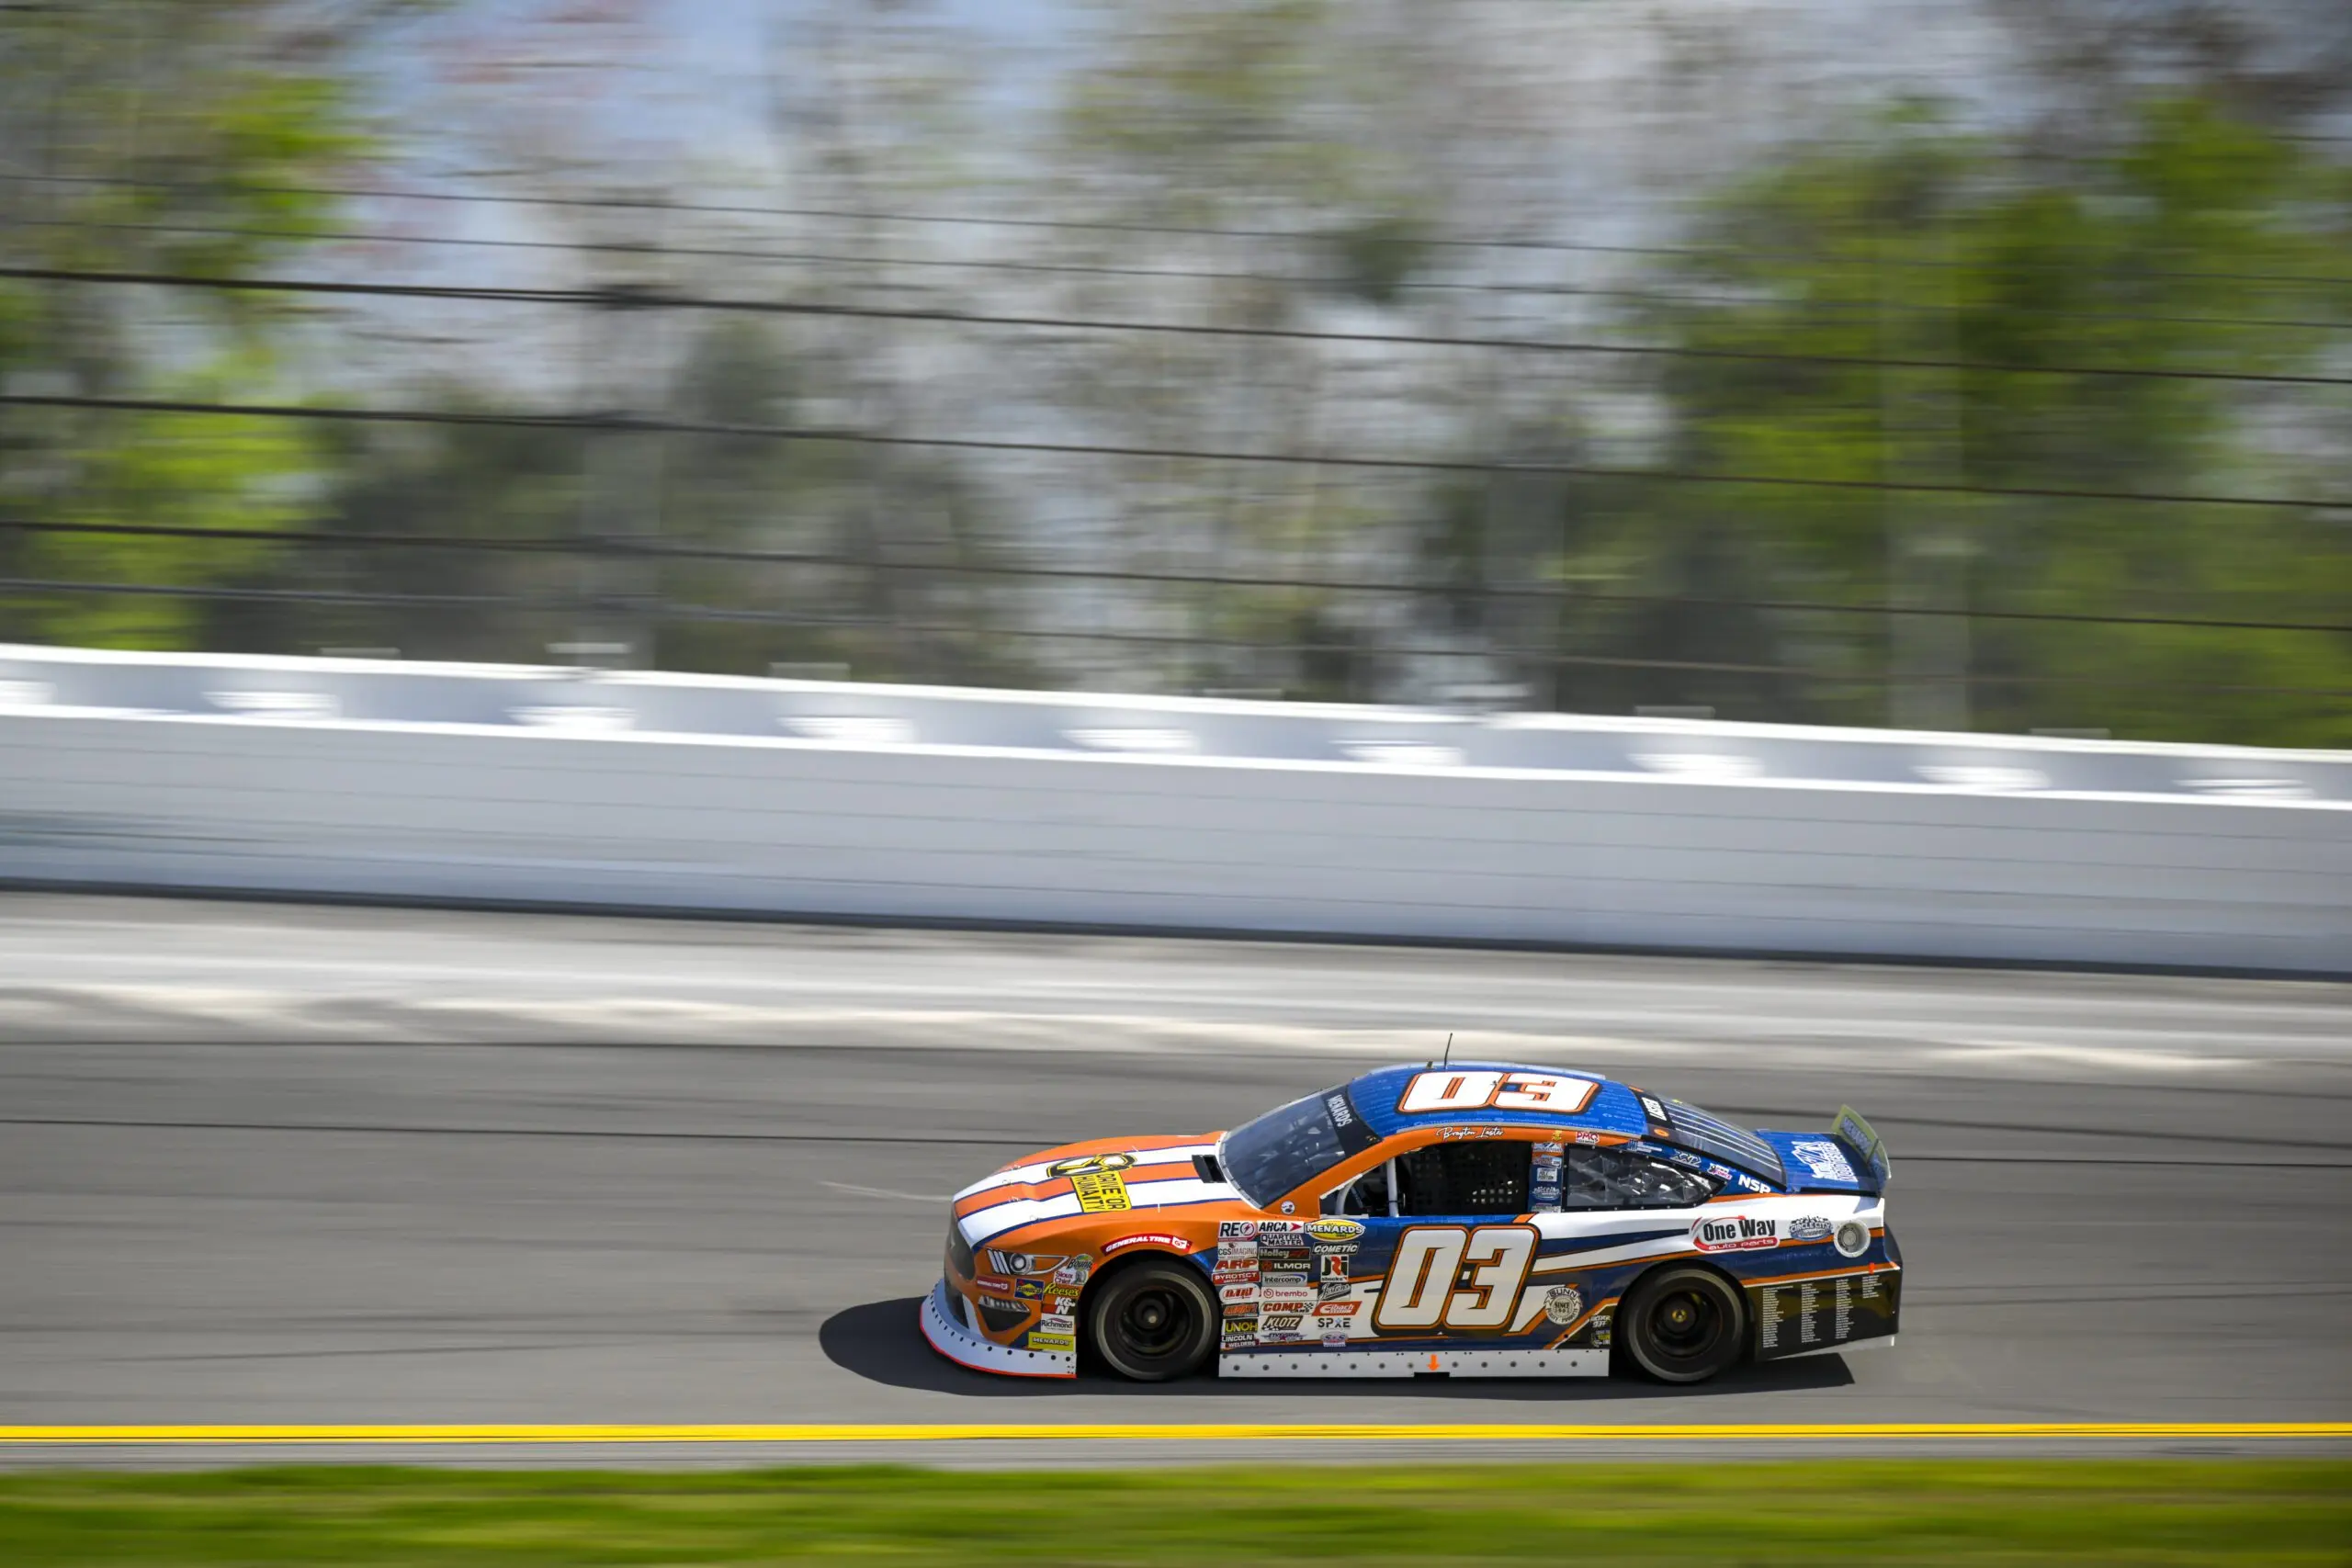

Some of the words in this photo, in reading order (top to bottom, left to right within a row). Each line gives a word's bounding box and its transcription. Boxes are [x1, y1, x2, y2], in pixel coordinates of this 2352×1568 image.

[1398, 1071, 1600, 1113] 03
[1327, 1094, 1352, 1127] MENARDS
[1436, 1126, 1476, 1142] Brayton
[1475, 1126, 1504, 1138] Laster
[1738, 1175, 1770, 1193] NSP
[1259, 1222, 1286, 1232] ARCA
[1306, 1224, 1363, 1233] MENARDS
[1703, 1223, 1736, 1241] One
[1738, 1219, 1775, 1237] Way
[1105, 1236, 1148, 1252] GENERAL
[1148, 1235, 1170, 1244] TIRE
[1741, 1239, 1774, 1247] parts
[1260, 1248, 1290, 1258] Holley
[1215, 1259, 1258, 1269] ARP
[1374, 1225, 1540, 1329] 03
[1263, 1303, 1303, 1311] COMP
[1041, 1320, 1072, 1328] Richmond
[1226, 1322, 1258, 1332] UNOH
[1267, 1317, 1300, 1327] KLOTZ
[1033, 1337, 1069, 1346] MENARDS
